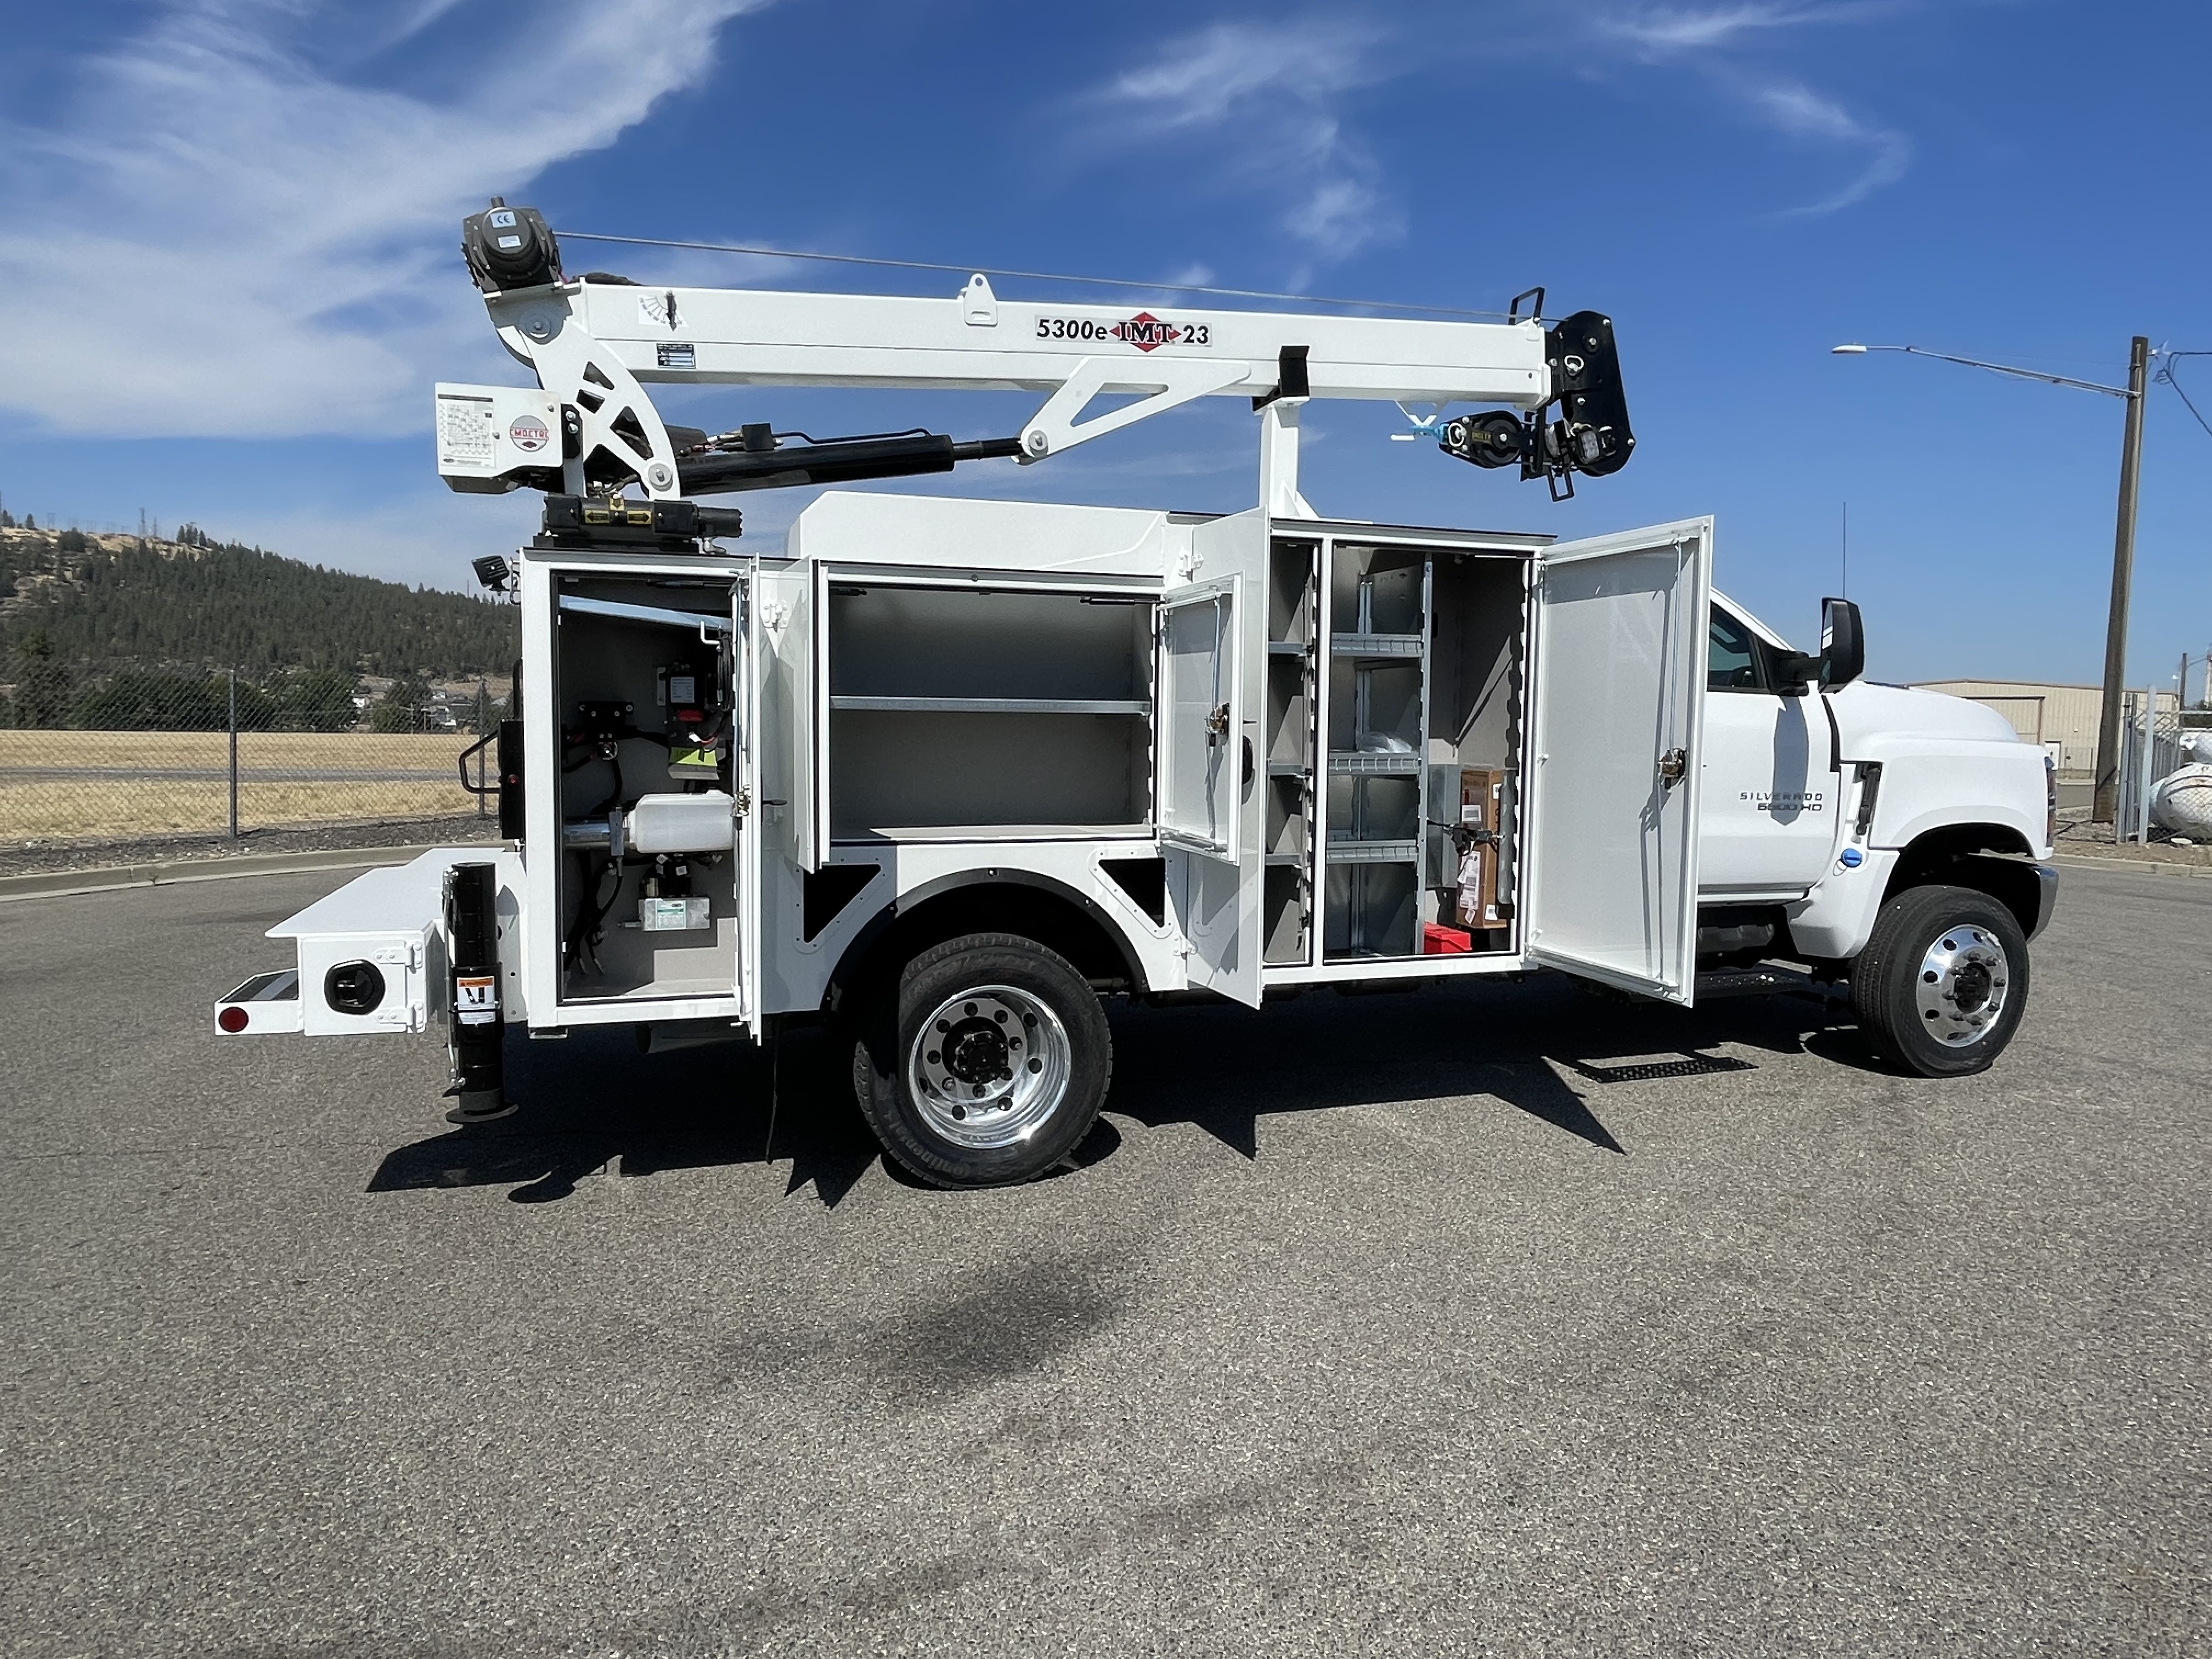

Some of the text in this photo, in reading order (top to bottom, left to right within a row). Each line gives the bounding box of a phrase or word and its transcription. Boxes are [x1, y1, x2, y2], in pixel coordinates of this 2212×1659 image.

[1036, 318, 1209, 344] 5300e IMT 23
